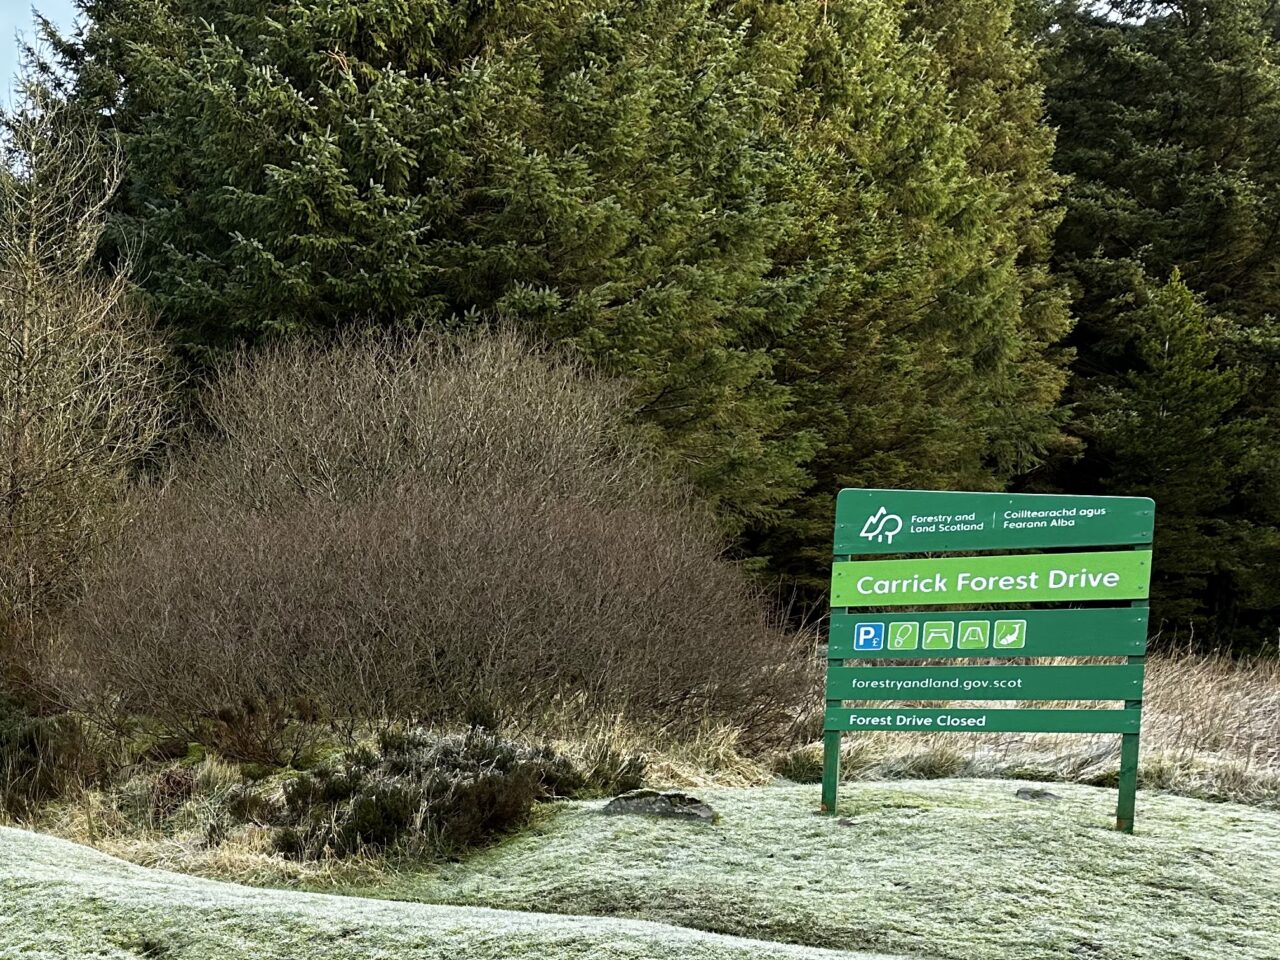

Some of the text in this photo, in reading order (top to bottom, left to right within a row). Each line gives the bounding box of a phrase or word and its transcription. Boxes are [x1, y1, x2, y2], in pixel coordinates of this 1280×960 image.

[911, 513, 976, 524] Forestry and
[1003, 508, 1106, 519] Coilltearachd agus
[910, 522, 984, 533] Land Scotland
[1003, 518, 1075, 529] Fearann Alba
[856, 568, 1120, 595] Carrick Forest Drive
[852, 678, 1022, 690] forestryandland.gov.scot
[849, 714, 986, 727] Forest Drive Closed
